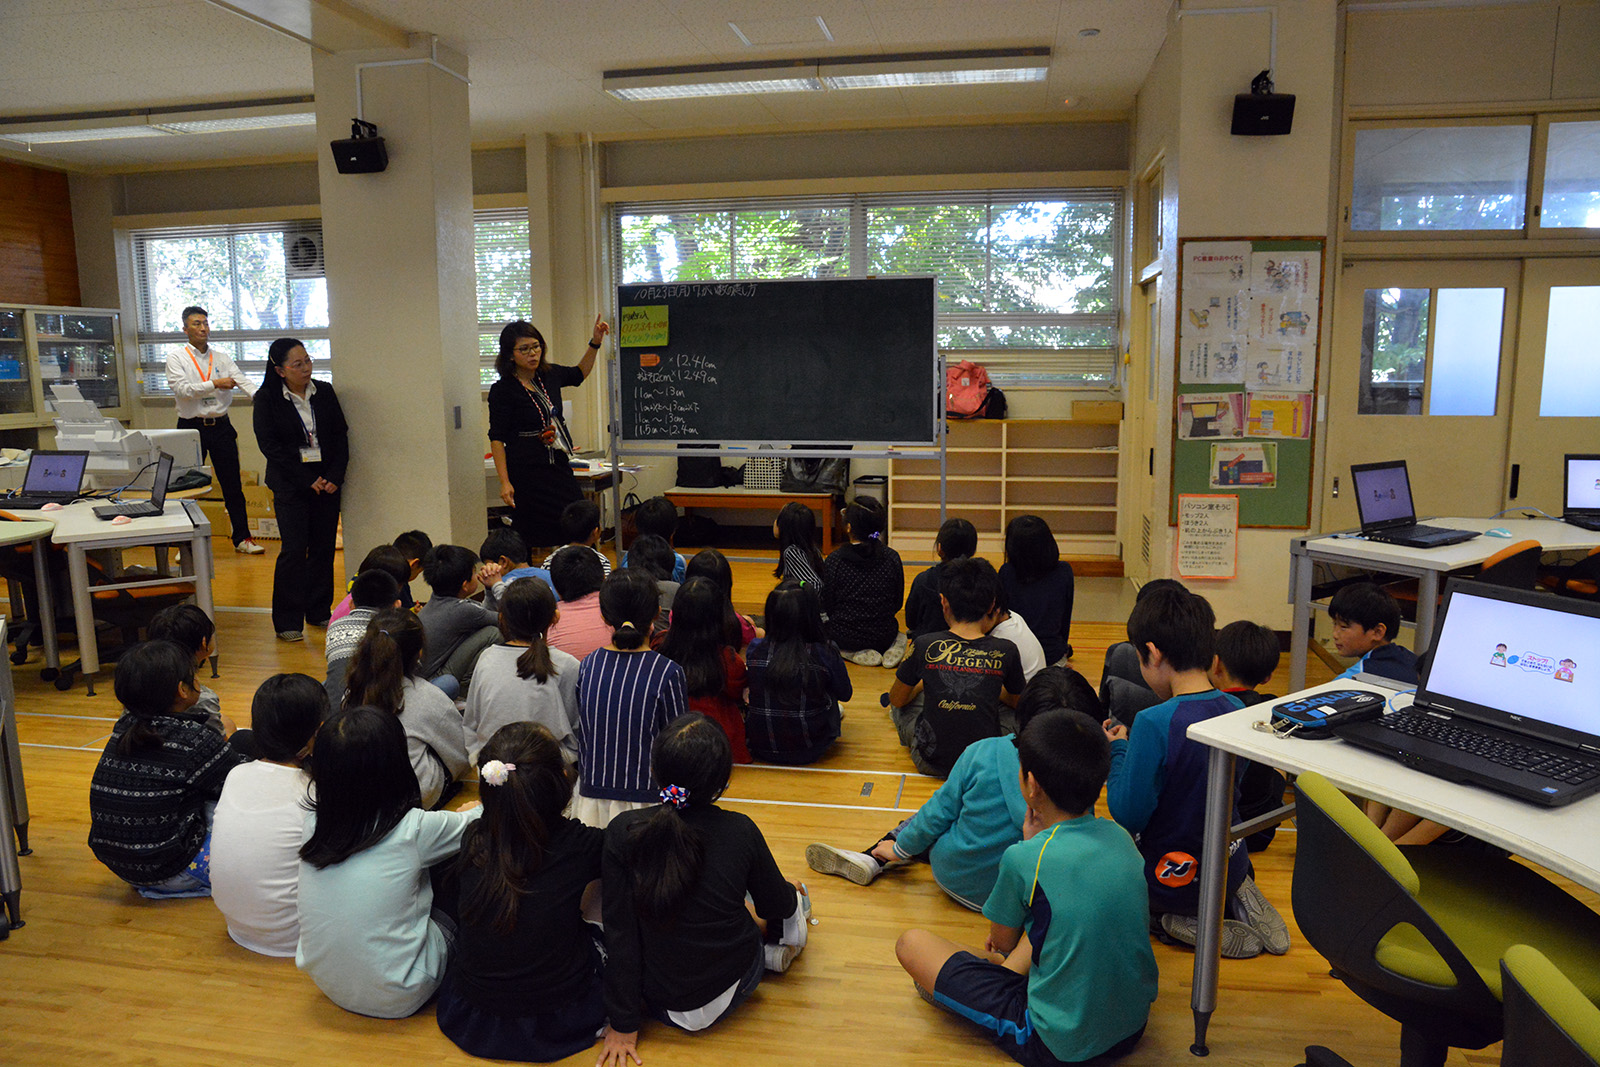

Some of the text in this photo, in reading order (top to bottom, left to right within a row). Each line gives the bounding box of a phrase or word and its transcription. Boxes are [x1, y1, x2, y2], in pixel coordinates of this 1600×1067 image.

[1184, 503, 1232, 511] パソコン室そうじ
[925, 663, 952, 672] CREATIVE
[953, 665, 984, 674] PLANNING
[938, 699, 977, 712] California
